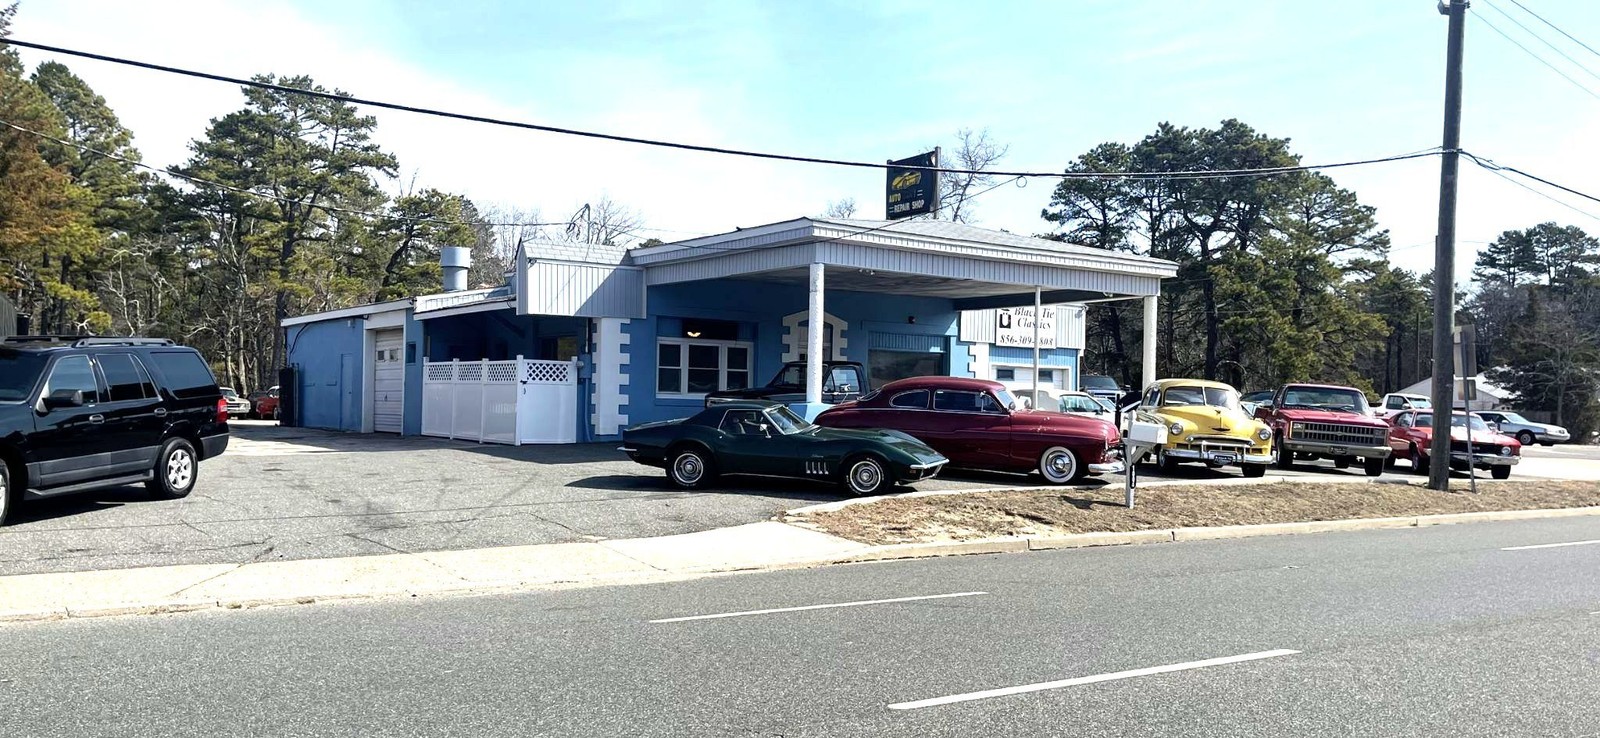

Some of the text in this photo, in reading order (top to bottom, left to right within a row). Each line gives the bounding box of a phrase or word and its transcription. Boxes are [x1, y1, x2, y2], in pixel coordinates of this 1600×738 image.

[889, 193, 901, 202] AUTO
[894, 199, 925, 213] REPAIR SHOP
[1042, 308, 1054, 318] Tie
